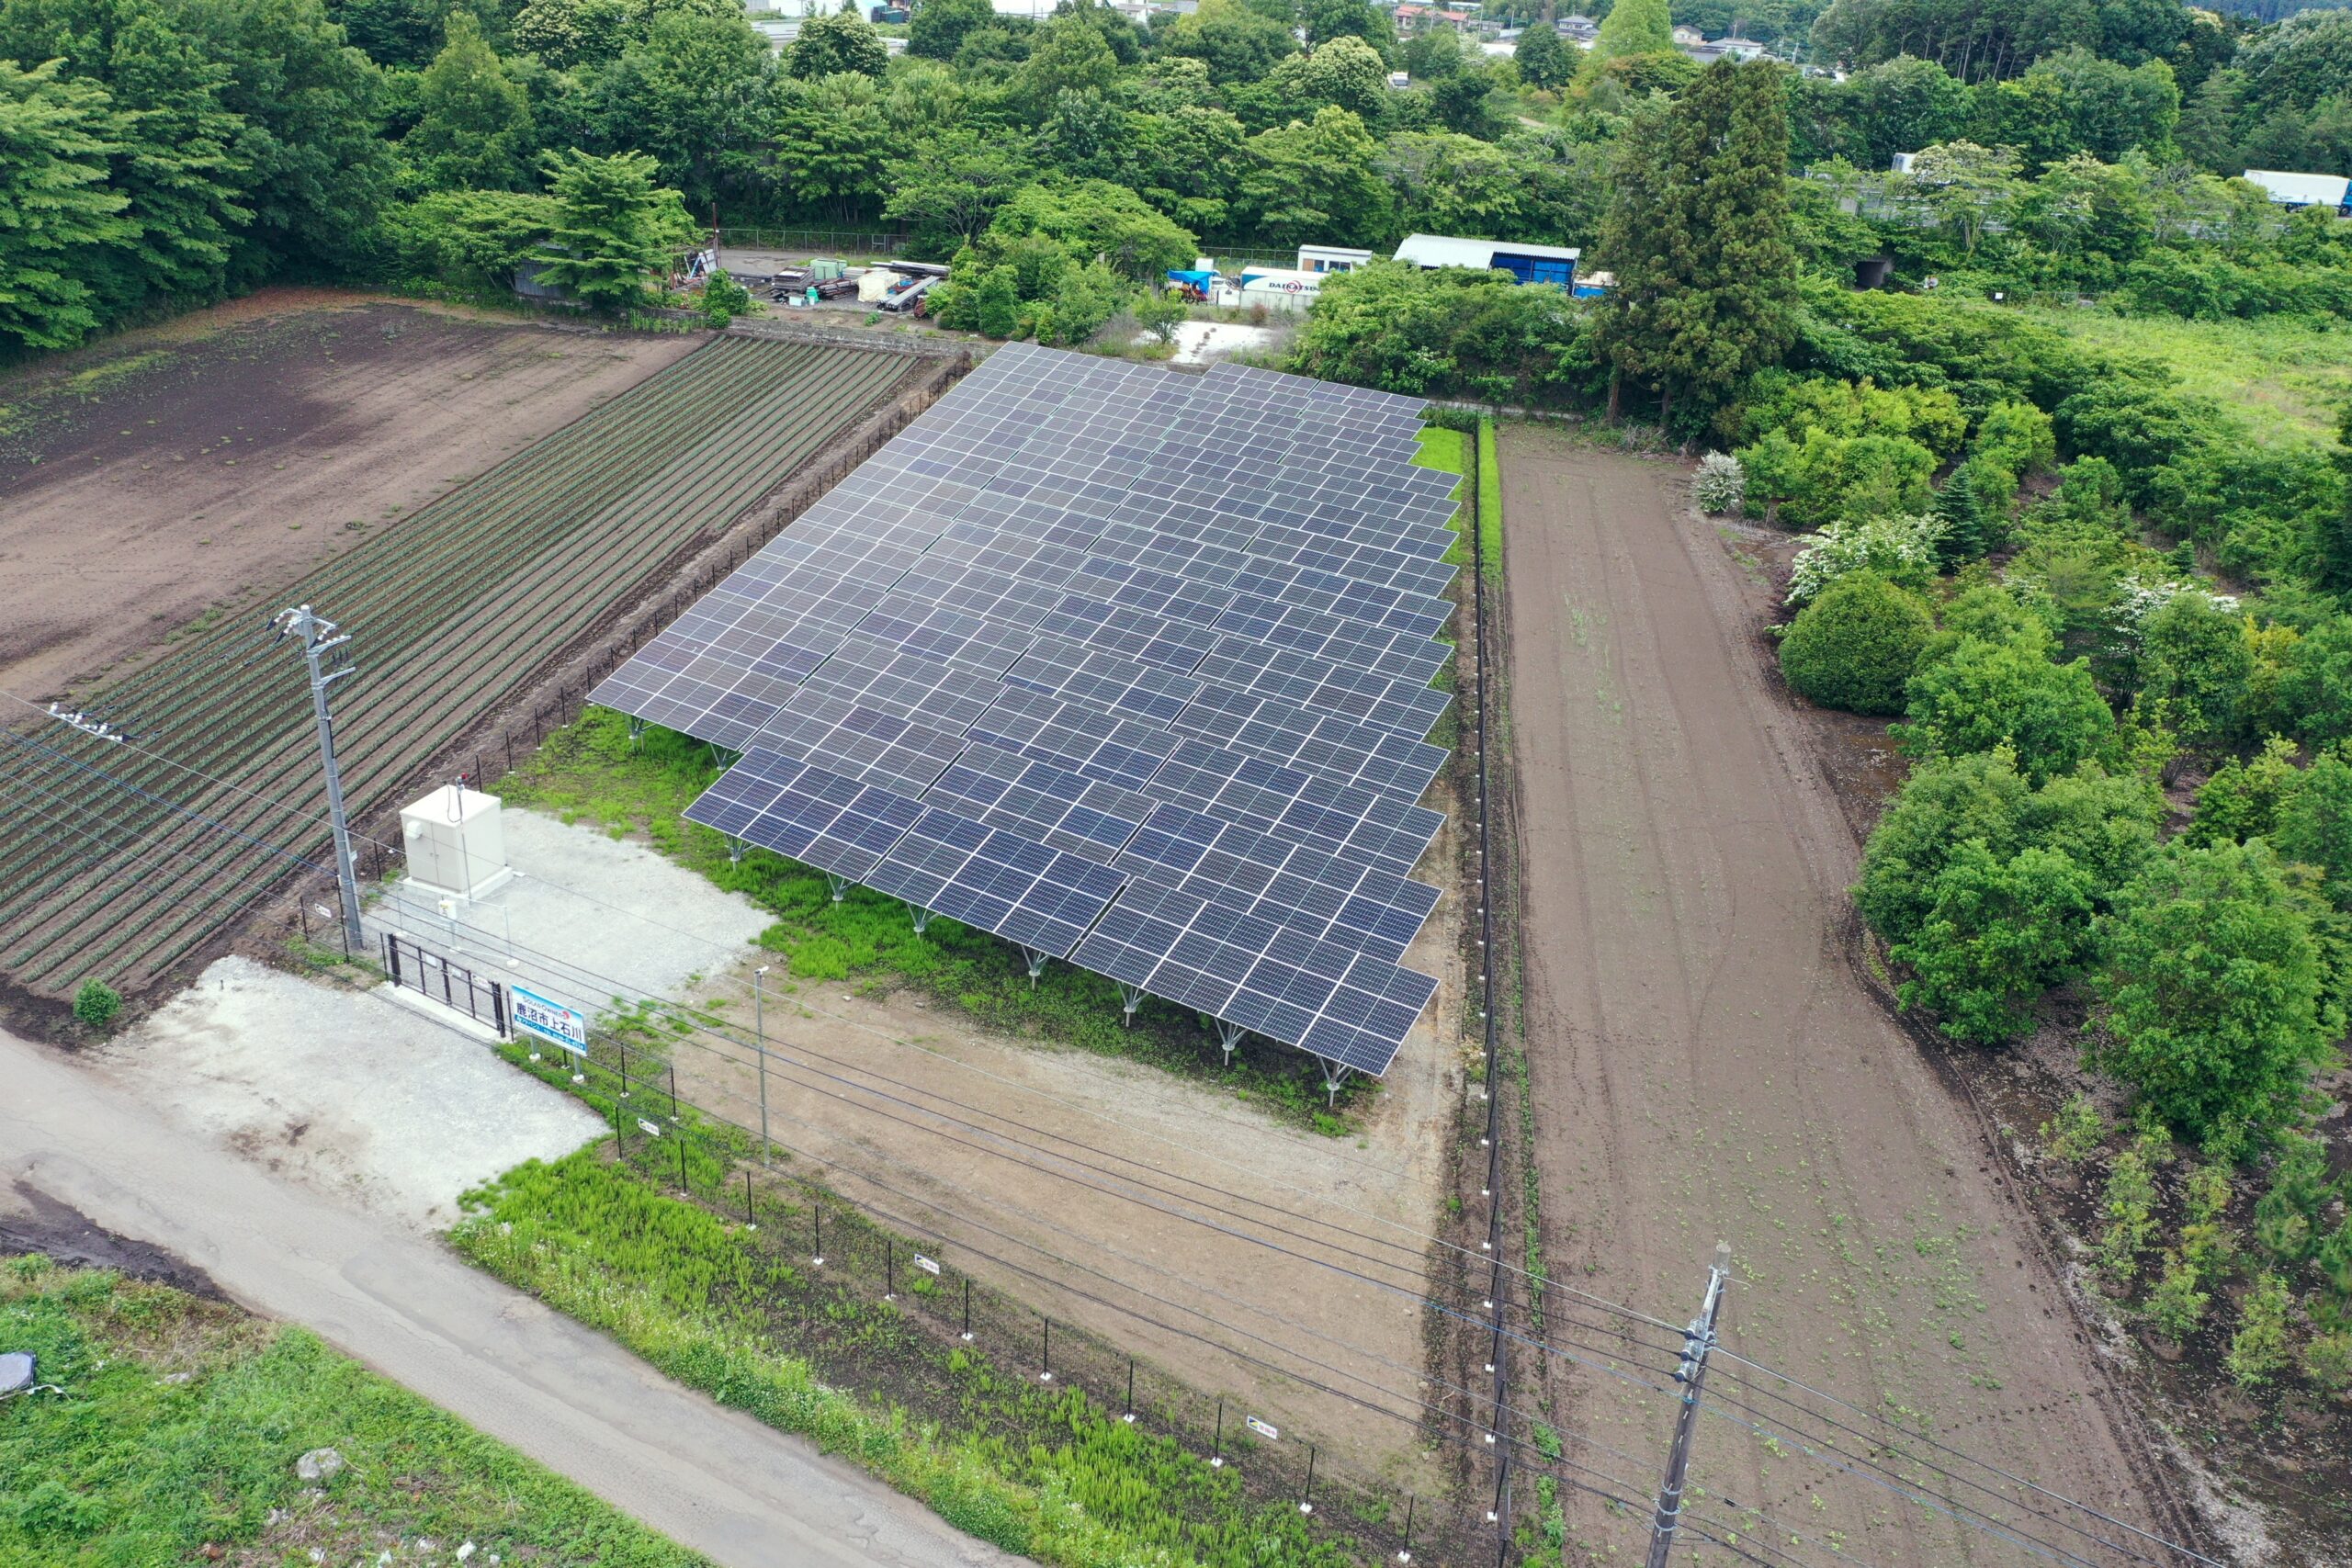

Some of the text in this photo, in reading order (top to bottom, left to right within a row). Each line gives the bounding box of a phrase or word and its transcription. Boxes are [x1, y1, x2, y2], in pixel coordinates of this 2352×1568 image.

[516, 1002, 582, 1042] 鹿沼市上石川
